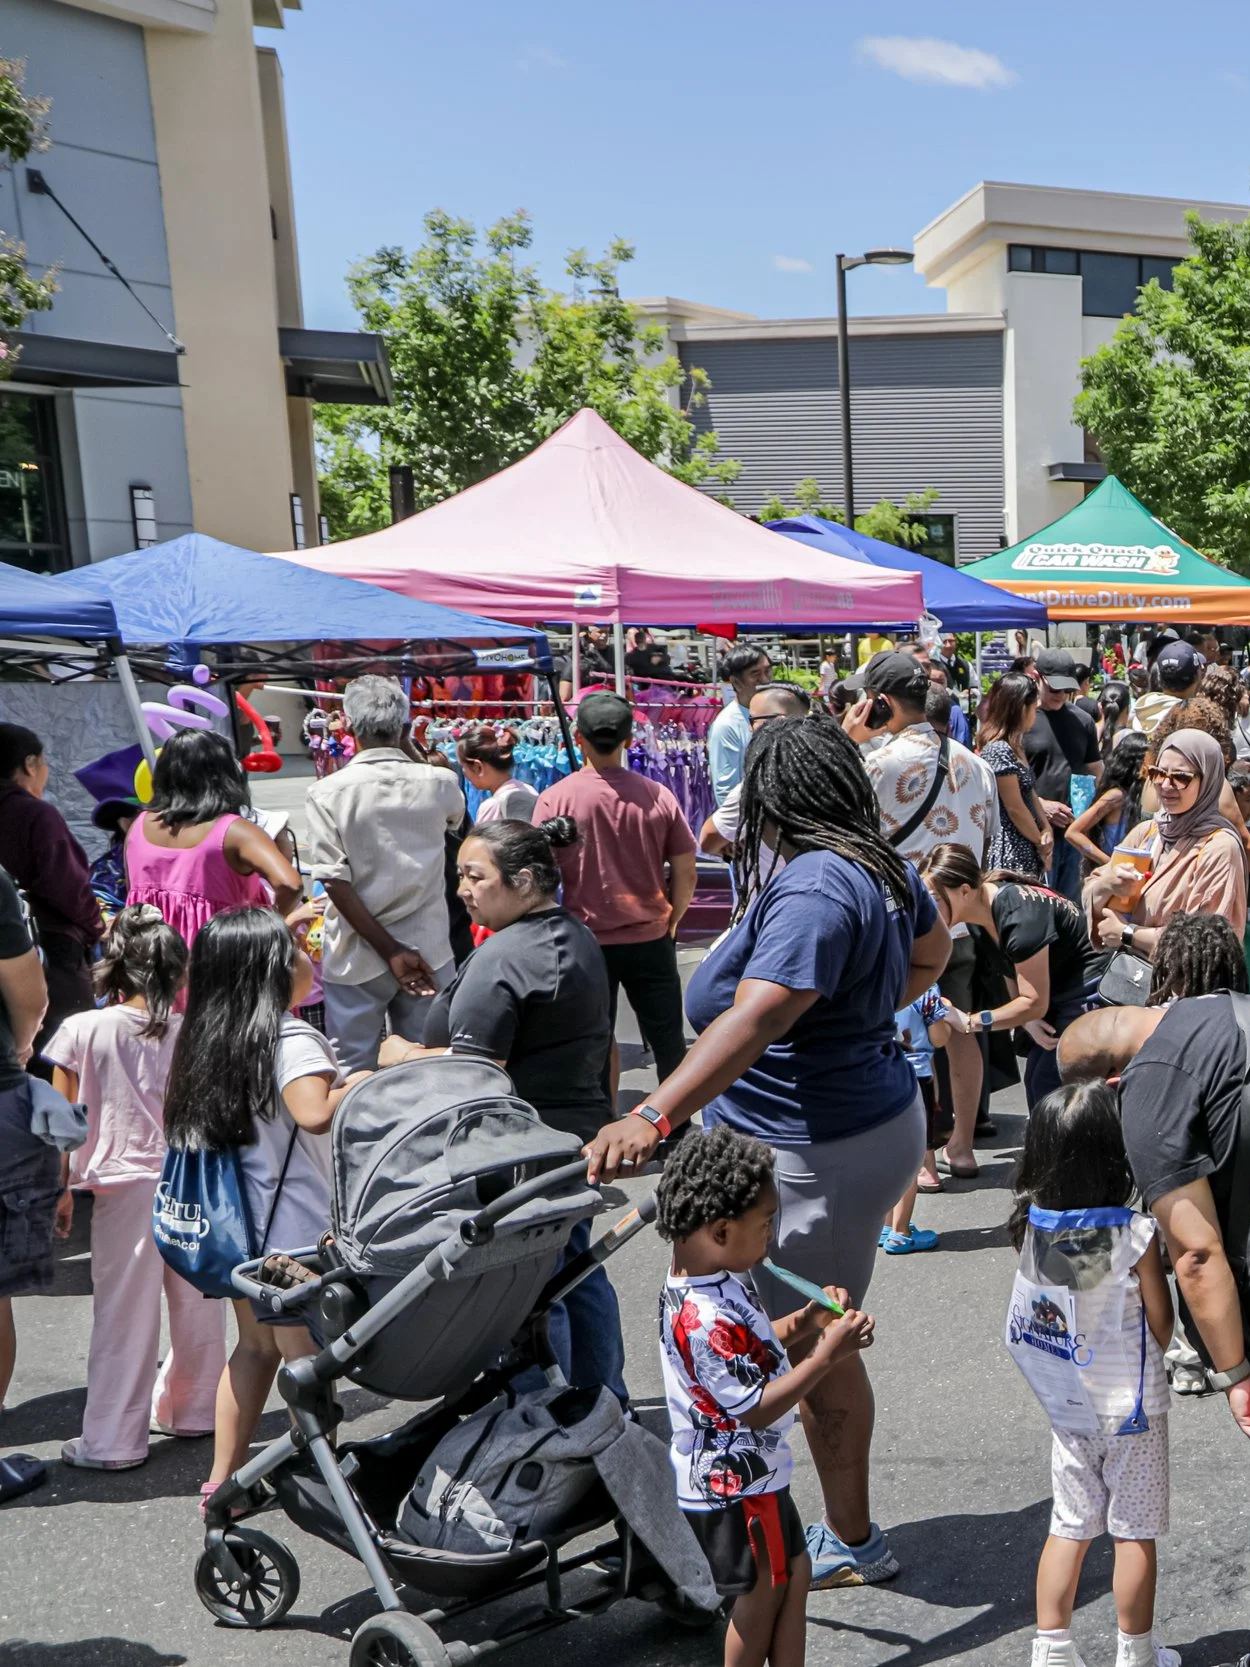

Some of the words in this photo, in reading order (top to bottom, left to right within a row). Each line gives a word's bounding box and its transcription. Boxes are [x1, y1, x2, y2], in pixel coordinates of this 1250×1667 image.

[1029, 546, 1082, 554] Quick
[1089, 546, 1148, 555] Quack
[1031, 553, 1079, 567] CAR
[1080, 554, 1146, 568] WASH
